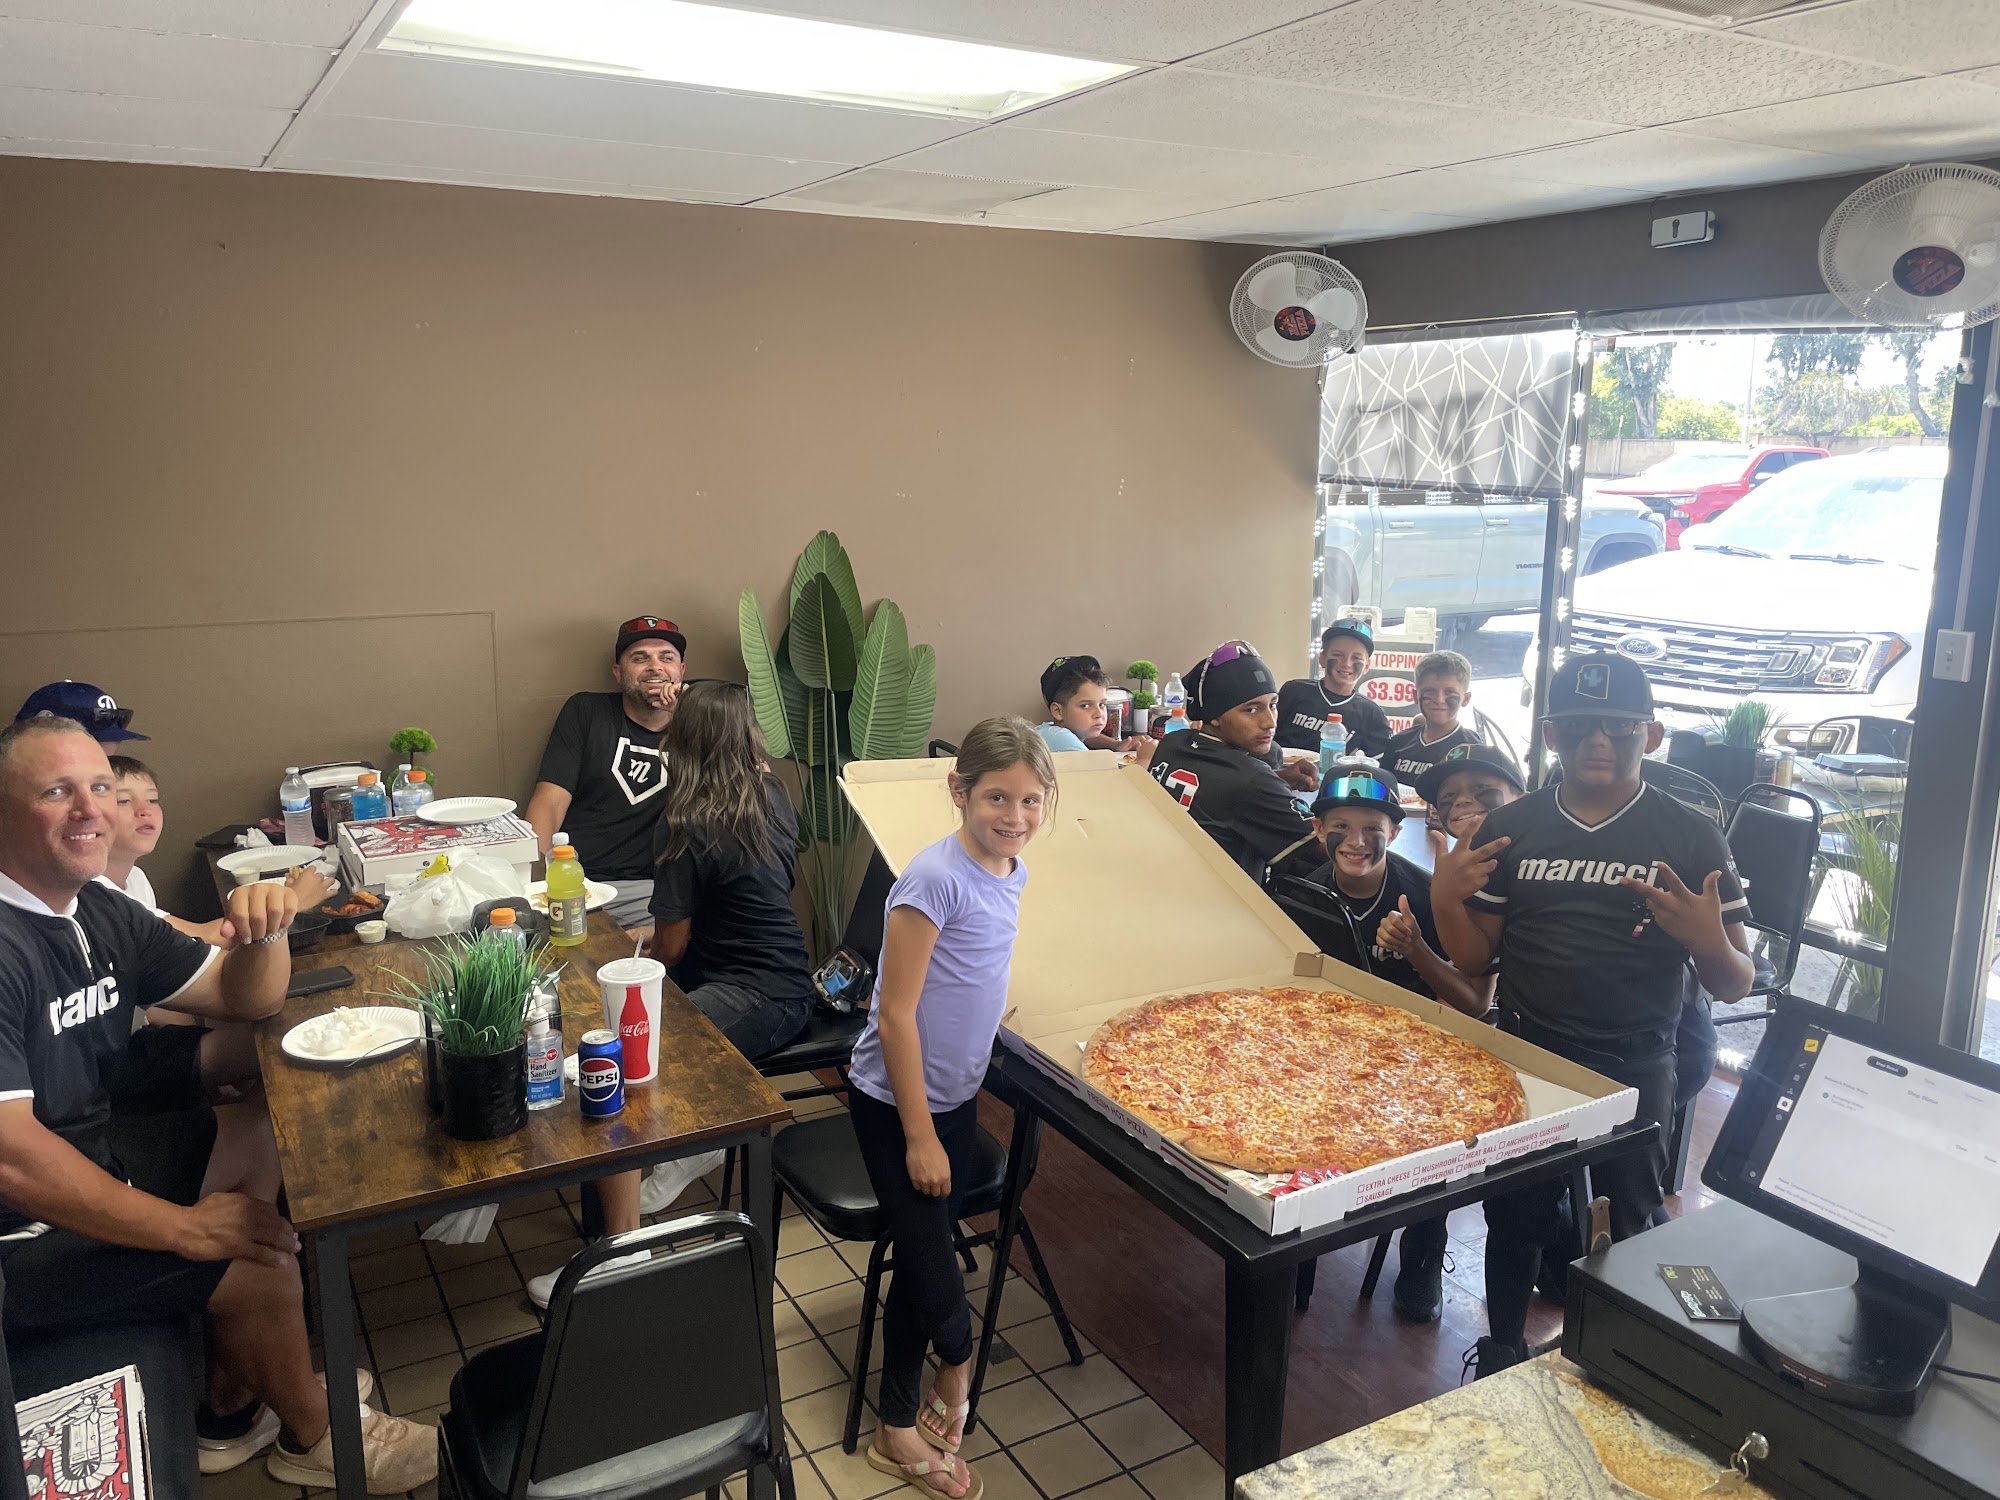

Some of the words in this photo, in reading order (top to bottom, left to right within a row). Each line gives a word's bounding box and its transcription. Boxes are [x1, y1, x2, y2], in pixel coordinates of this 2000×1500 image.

[1366, 680, 1416, 702] $3.99
[530, 1062, 547, 1071] Hand
[530, 1068, 557, 1079] Sanitizer
[580, 1071, 618, 1085] PEPSI
[1086, 1089, 1111, 1113] FRESH
[1111, 1107, 1126, 1122] HOT
[1126, 1117, 1149, 1138] PIZZA
[1506, 1132, 1539, 1148] ANCHOVIES
[1539, 1122, 1570, 1138] CUSTOMER
[1538, 1135, 1561, 1147] SPECIAL
[1465, 1150, 1482, 1160] MEAT
[1482, 1144, 1497, 1155] BALL
[1503, 1145, 1530, 1158] PEPPERS
[1421, 1157, 1459, 1173] MUSHROOM
[1463, 1158, 1487, 1171] ONIONS
[1364, 1178, 1387, 1192] EXTRA
[1387, 1171, 1411, 1185] CHEESE
[1419, 1168, 1455, 1185] PEPPERONI
[1364, 1187, 1394, 1203] SAUSAGE
